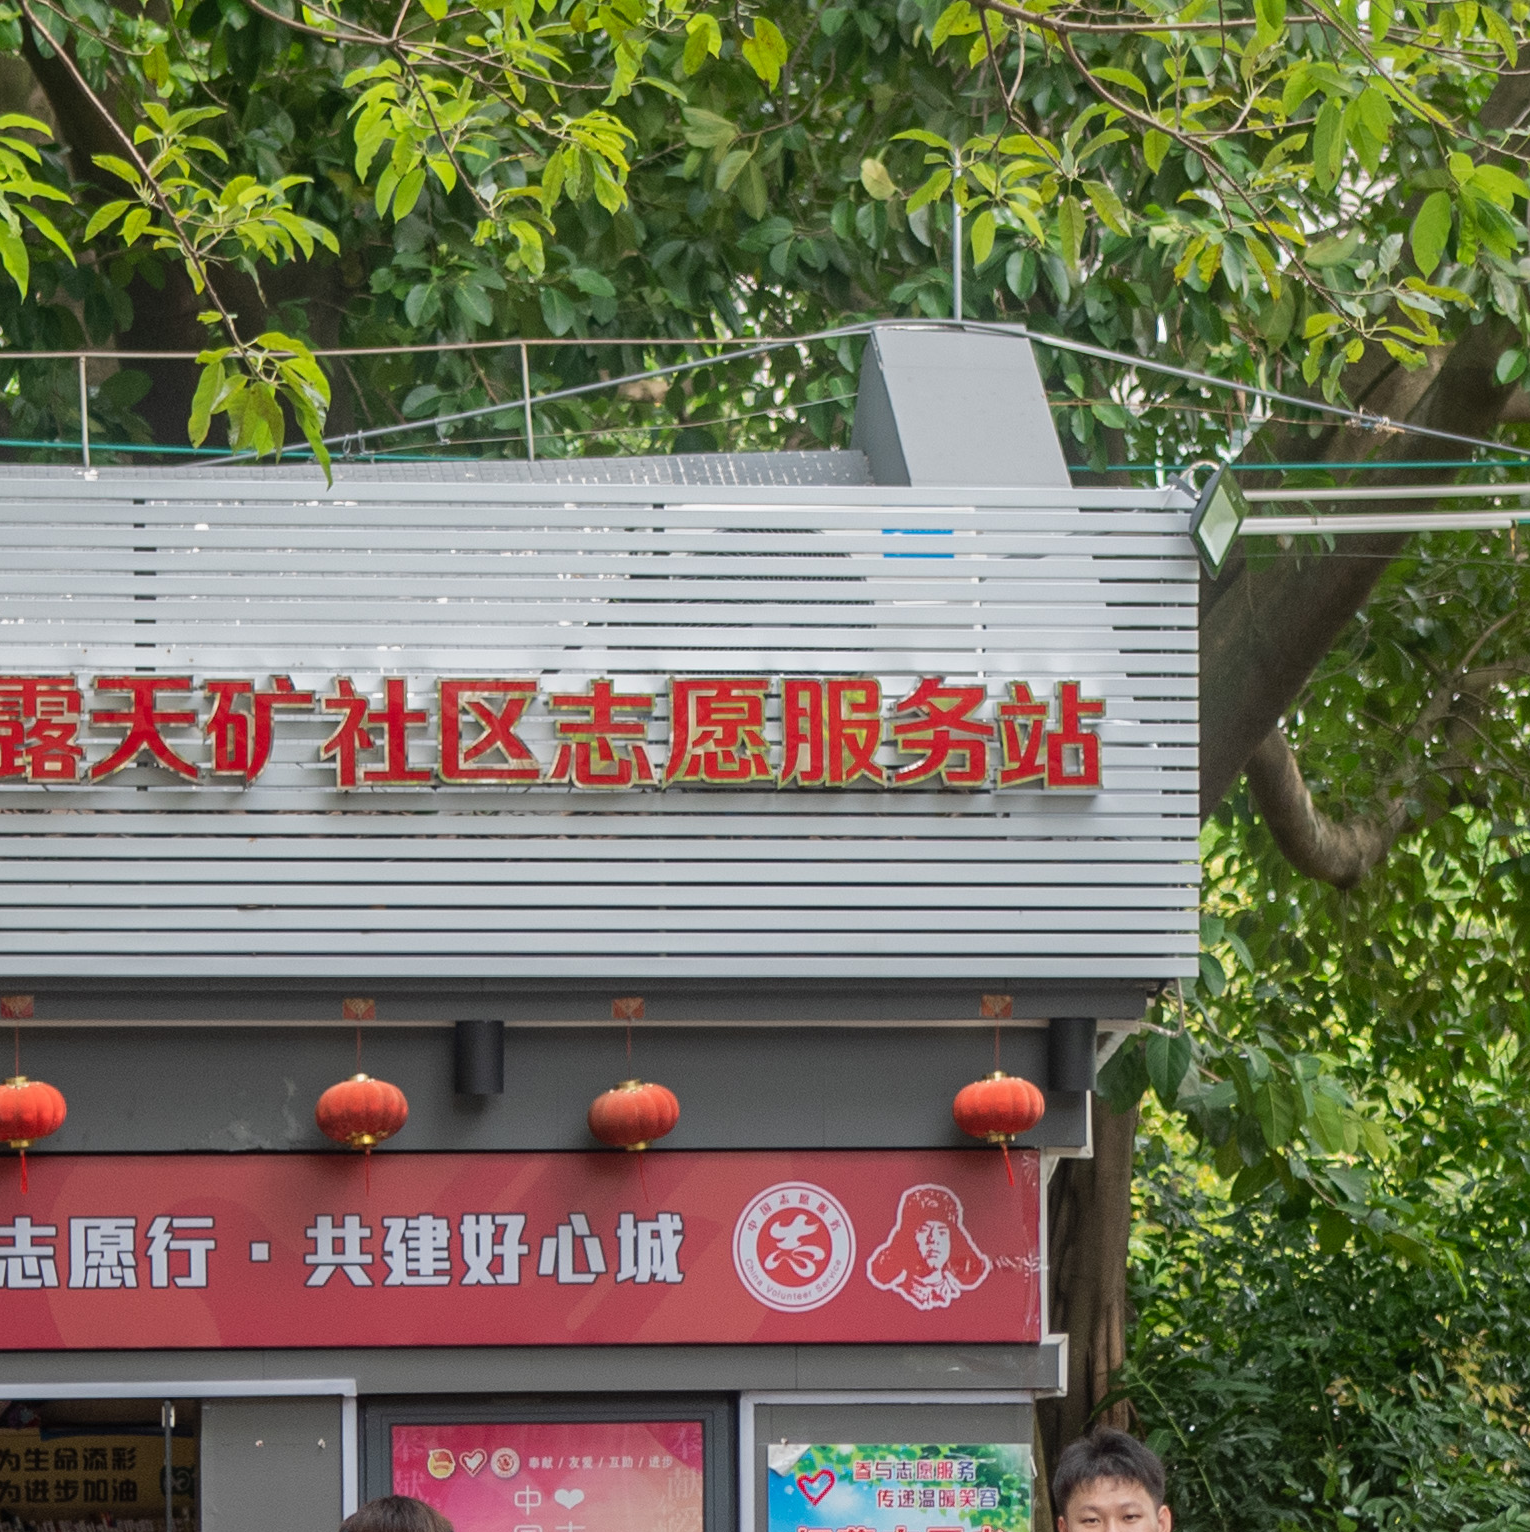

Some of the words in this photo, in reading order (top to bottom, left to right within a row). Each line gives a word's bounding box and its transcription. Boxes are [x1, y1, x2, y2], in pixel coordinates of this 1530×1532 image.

[876, 1488, 999, 1509] 传递温暖笑容
